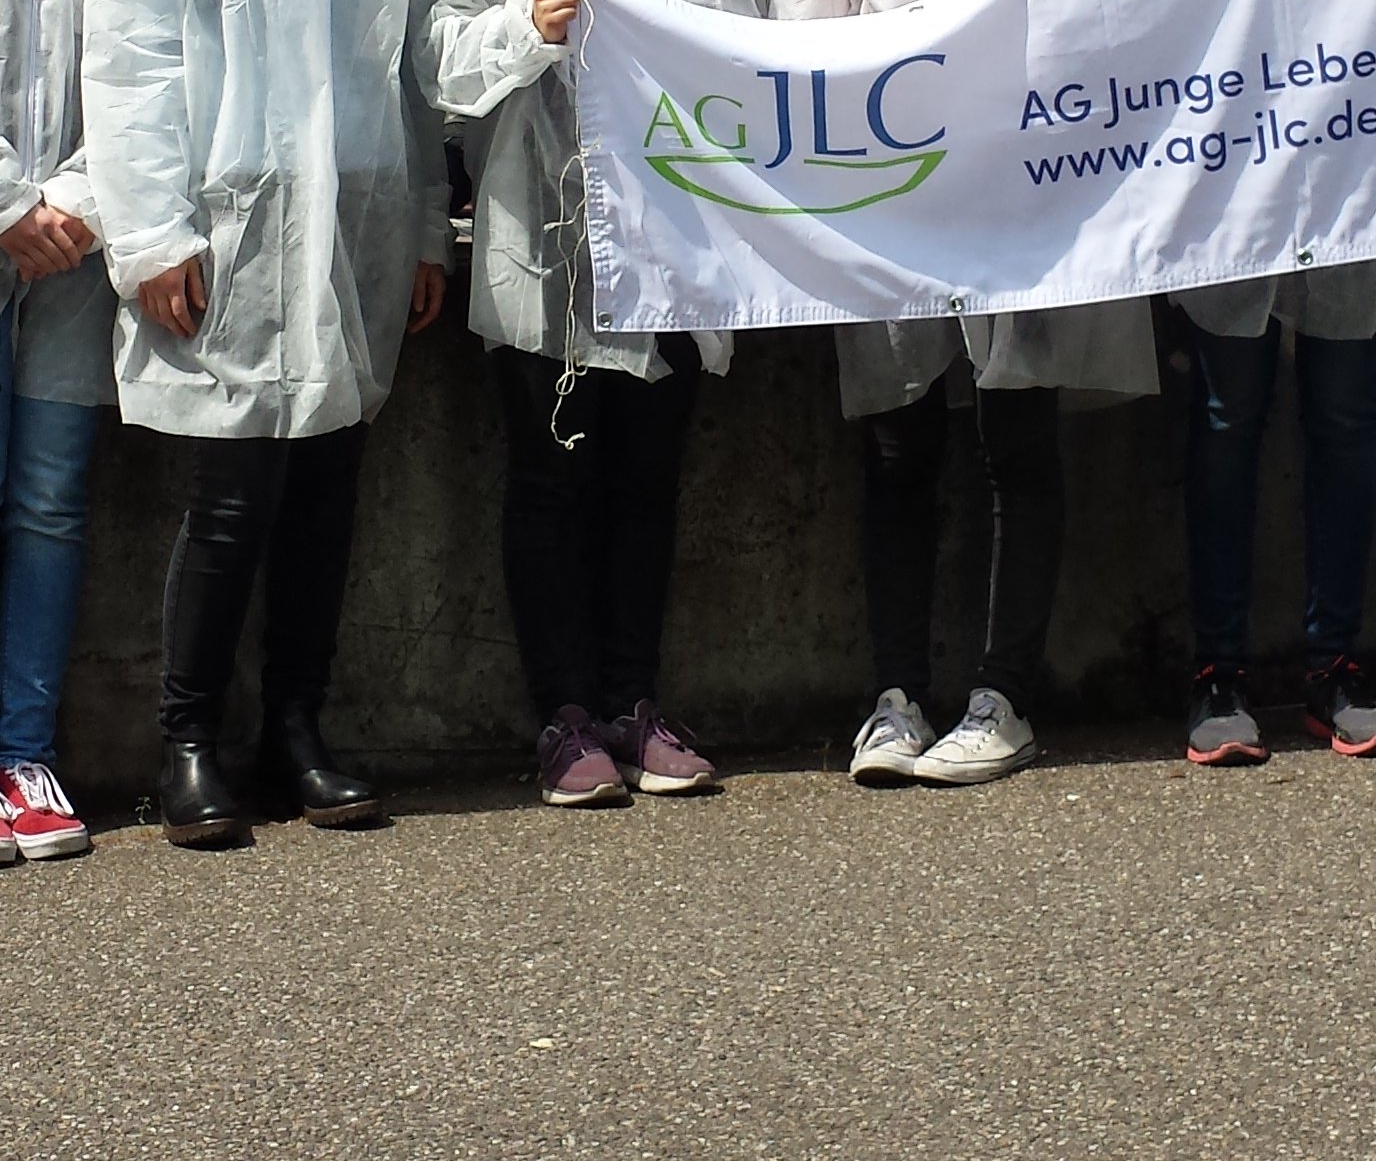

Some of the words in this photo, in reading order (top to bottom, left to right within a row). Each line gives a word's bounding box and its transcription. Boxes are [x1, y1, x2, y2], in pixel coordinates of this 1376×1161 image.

[643, 91, 747, 149] AG
[756, 54, 947, 168] JLC
[1019, 82, 1092, 130] AG
[1104, 69, 1245, 129] Junge
